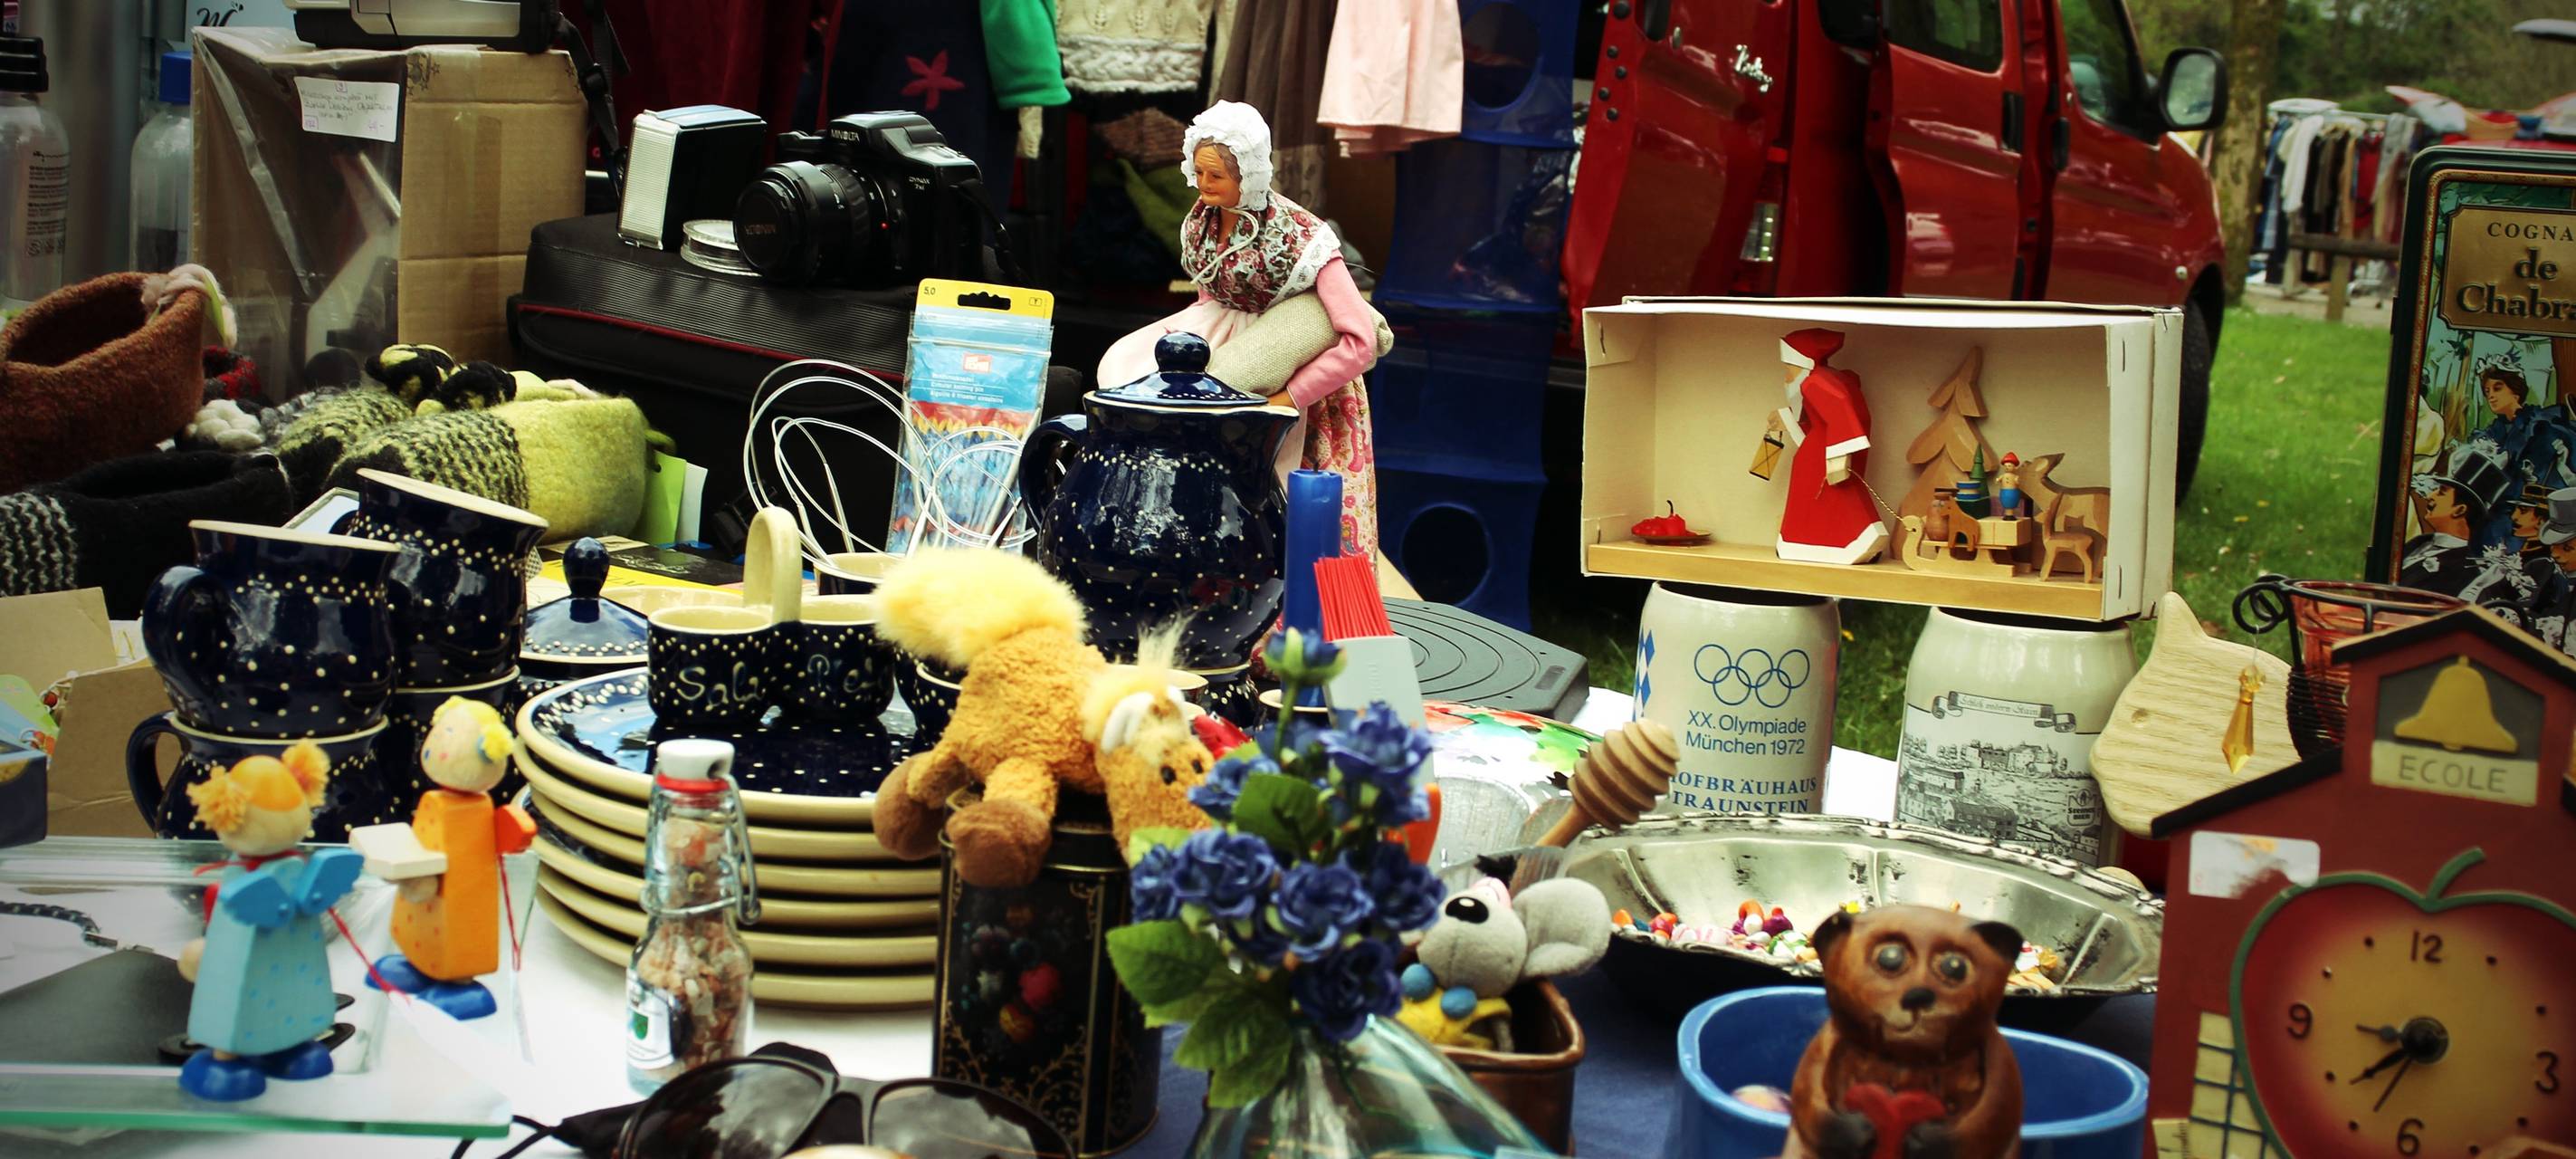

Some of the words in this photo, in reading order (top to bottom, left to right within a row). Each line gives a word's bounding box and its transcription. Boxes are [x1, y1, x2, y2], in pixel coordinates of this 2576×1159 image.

[831, 129, 860, 141] MINOLTA
[908, 176, 930, 184] DYNAX
[2514, 246, 2559, 281] de
[1687, 710, 1716, 730] XX.
[1719, 714, 1807, 737] Olympiade
[1685, 731, 1766, 755] München
[1770, 738, 1805, 755] 1972
[2399, 754, 2506, 794] ECOLE
[1672, 790, 1809, 814] TRAUNSTEIN
[2410, 930, 2444, 964] 12
[2286, 1002, 2313, 1040] 9
[2535, 1050, 2561, 1095] 3
[2397, 1117, 2425, 1157] 6
